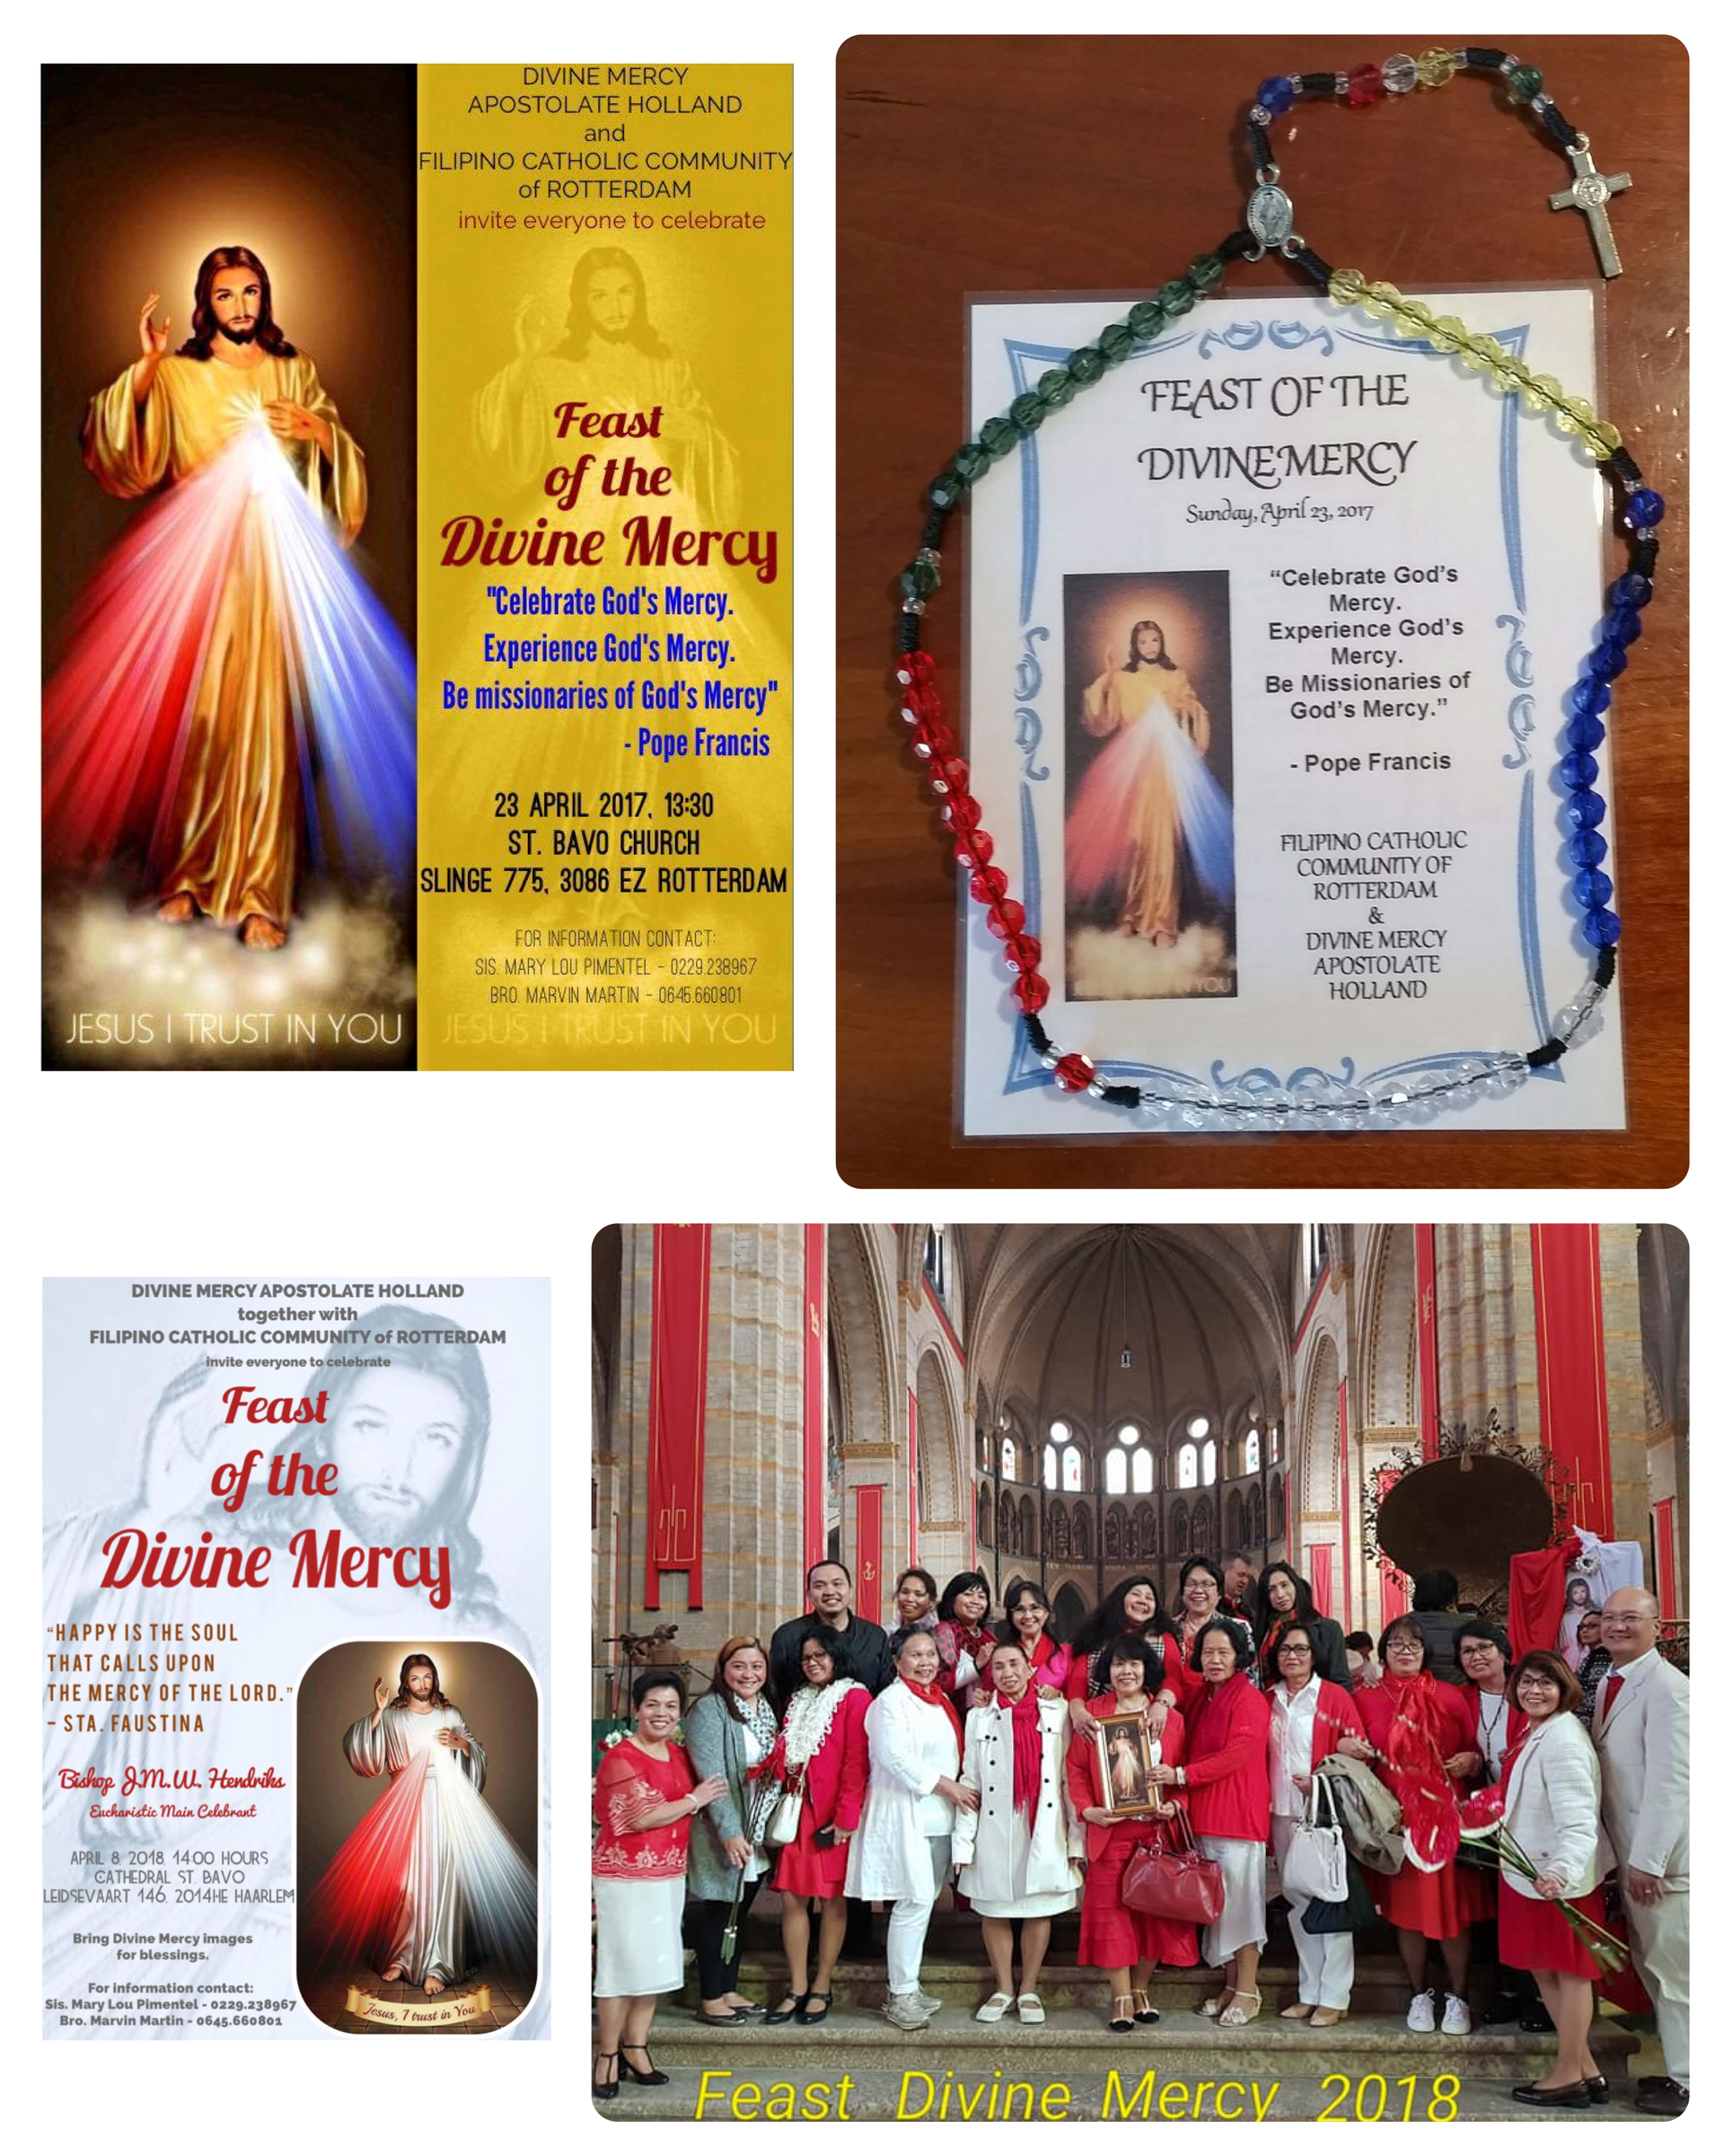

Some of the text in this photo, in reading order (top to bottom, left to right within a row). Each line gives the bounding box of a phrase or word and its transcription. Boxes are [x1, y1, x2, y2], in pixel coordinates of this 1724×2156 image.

[523, 66, 689, 85] DIVINE MERCY
[467, 95, 743, 114] APOSTOLATE HOLLAND
[584, 123, 626, 142] and
[419, 152, 794, 171] FILIPINO CATHOLIC COMMUNITY
[518, 179, 691, 198] of ROTTERDAM
[459, 210, 766, 234] invite everyone to celebrate
[1141, 374, 1410, 419] FEAST OF THE
[553, 401, 664, 439] Feast
[1138, 440, 1418, 490] DIVINE MERCY
[543, 453, 673, 512] of the
[1185, 495, 1375, 528] Sunday, April 23, 2017
[441, 515, 778, 584] Divine Mercy
[1394, 565, 1458, 584] God’s
[602, 585, 658, 616] God's
[664, 585, 734, 623] Mercy.
[1329, 594, 1402, 615] Mercy.
[1268, 617, 1465, 644] Experience God’s
[484, 632, 736, 670] Experience God's Mercy.
[1331, 647, 1403, 669] Mercy.
[1265, 670, 1473, 694] Be Missionaries of
[443, 680, 469, 710] Be
[475, 680, 609, 710] missionaries
[614, 680, 636, 709] of
[641, 679, 699, 710] God's
[1290, 700, 1356, 720] God’s
[638, 726, 770, 763] Pope Francis
[1305, 751, 1451, 777] Pope Francis
[494, 791, 714, 820] 23 APRIL 2017, 13:30
[507, 829, 699, 856] ST. BAVO CHURCH
[1280, 830, 1468, 852] FILIPINO CATHOLIC
[1297, 855, 1453, 877] COMMUNITY OF
[420, 867, 787, 895] SLINGE 775, 3086 EZ ROTTERDAM
[1312, 880, 1438, 901] ROTTERDAM
[1305, 928, 1447, 951] DIVINE MERCY
[1313, 955, 1441, 976] APOSTOLATE
[1328, 980, 1428, 1000] HOLLAND
[66, 1013, 402, 1045] JESUS I TRUST IN YOU
[131, 1283, 465, 1298] DIVINE MERCY APOSTOLATE HOLLAND
[237, 1306, 358, 1325] together with
[90, 1329, 506, 1344] FILIPINO CATHOLIC COMMUNITY of ROTTERDAM
[222, 1386, 330, 1424] Feast
[210, 1449, 339, 1513] of the
[100, 1528, 452, 1610] Divine Mercy
[125, 1623, 142, 1641] IS
[149, 1624, 184, 1641] THE
[191, 1623, 238, 1641] SOUL
[48, 1654, 215, 1672] THAT CALLS UPON
[47, 1684, 81, 1702] THE
[88, 1684, 151, 1703] MERCY
[159, 1684, 180, 1702] OF
[189, 1684, 223, 1702] THE
[64, 1714, 204, 1732] STA. FAUSTINA
[57, 1766, 116, 1797] Bishop
[208, 1766, 286, 1790] Hendriks
[89, 1803, 257, 1819] Eucharistic Main Celebrant
[94, 1870, 246, 1885] CATHEDRAL ST. BAVO
[43, 1884, 295, 1904] LEIDSEVAART 146, 2014HE HAARLEM
[73, 1932, 253, 1948] Bring Divine Mercy images
[116, 1949, 209, 1963] for blessings.
[88, 1982, 254, 1993] For information contact:
[45, 1998, 297, 2013] Sis. Mary Lou Pimentel 0229.238967
[363, 2002, 399, 2022] Jesus,
[411, 2011, 438, 2021] trust
[441, 2009, 452, 2020] in
[453, 2003, 477, 2017] You
[59, 2014, 283, 2028] Bro. Marvin Martin 0645.660801
